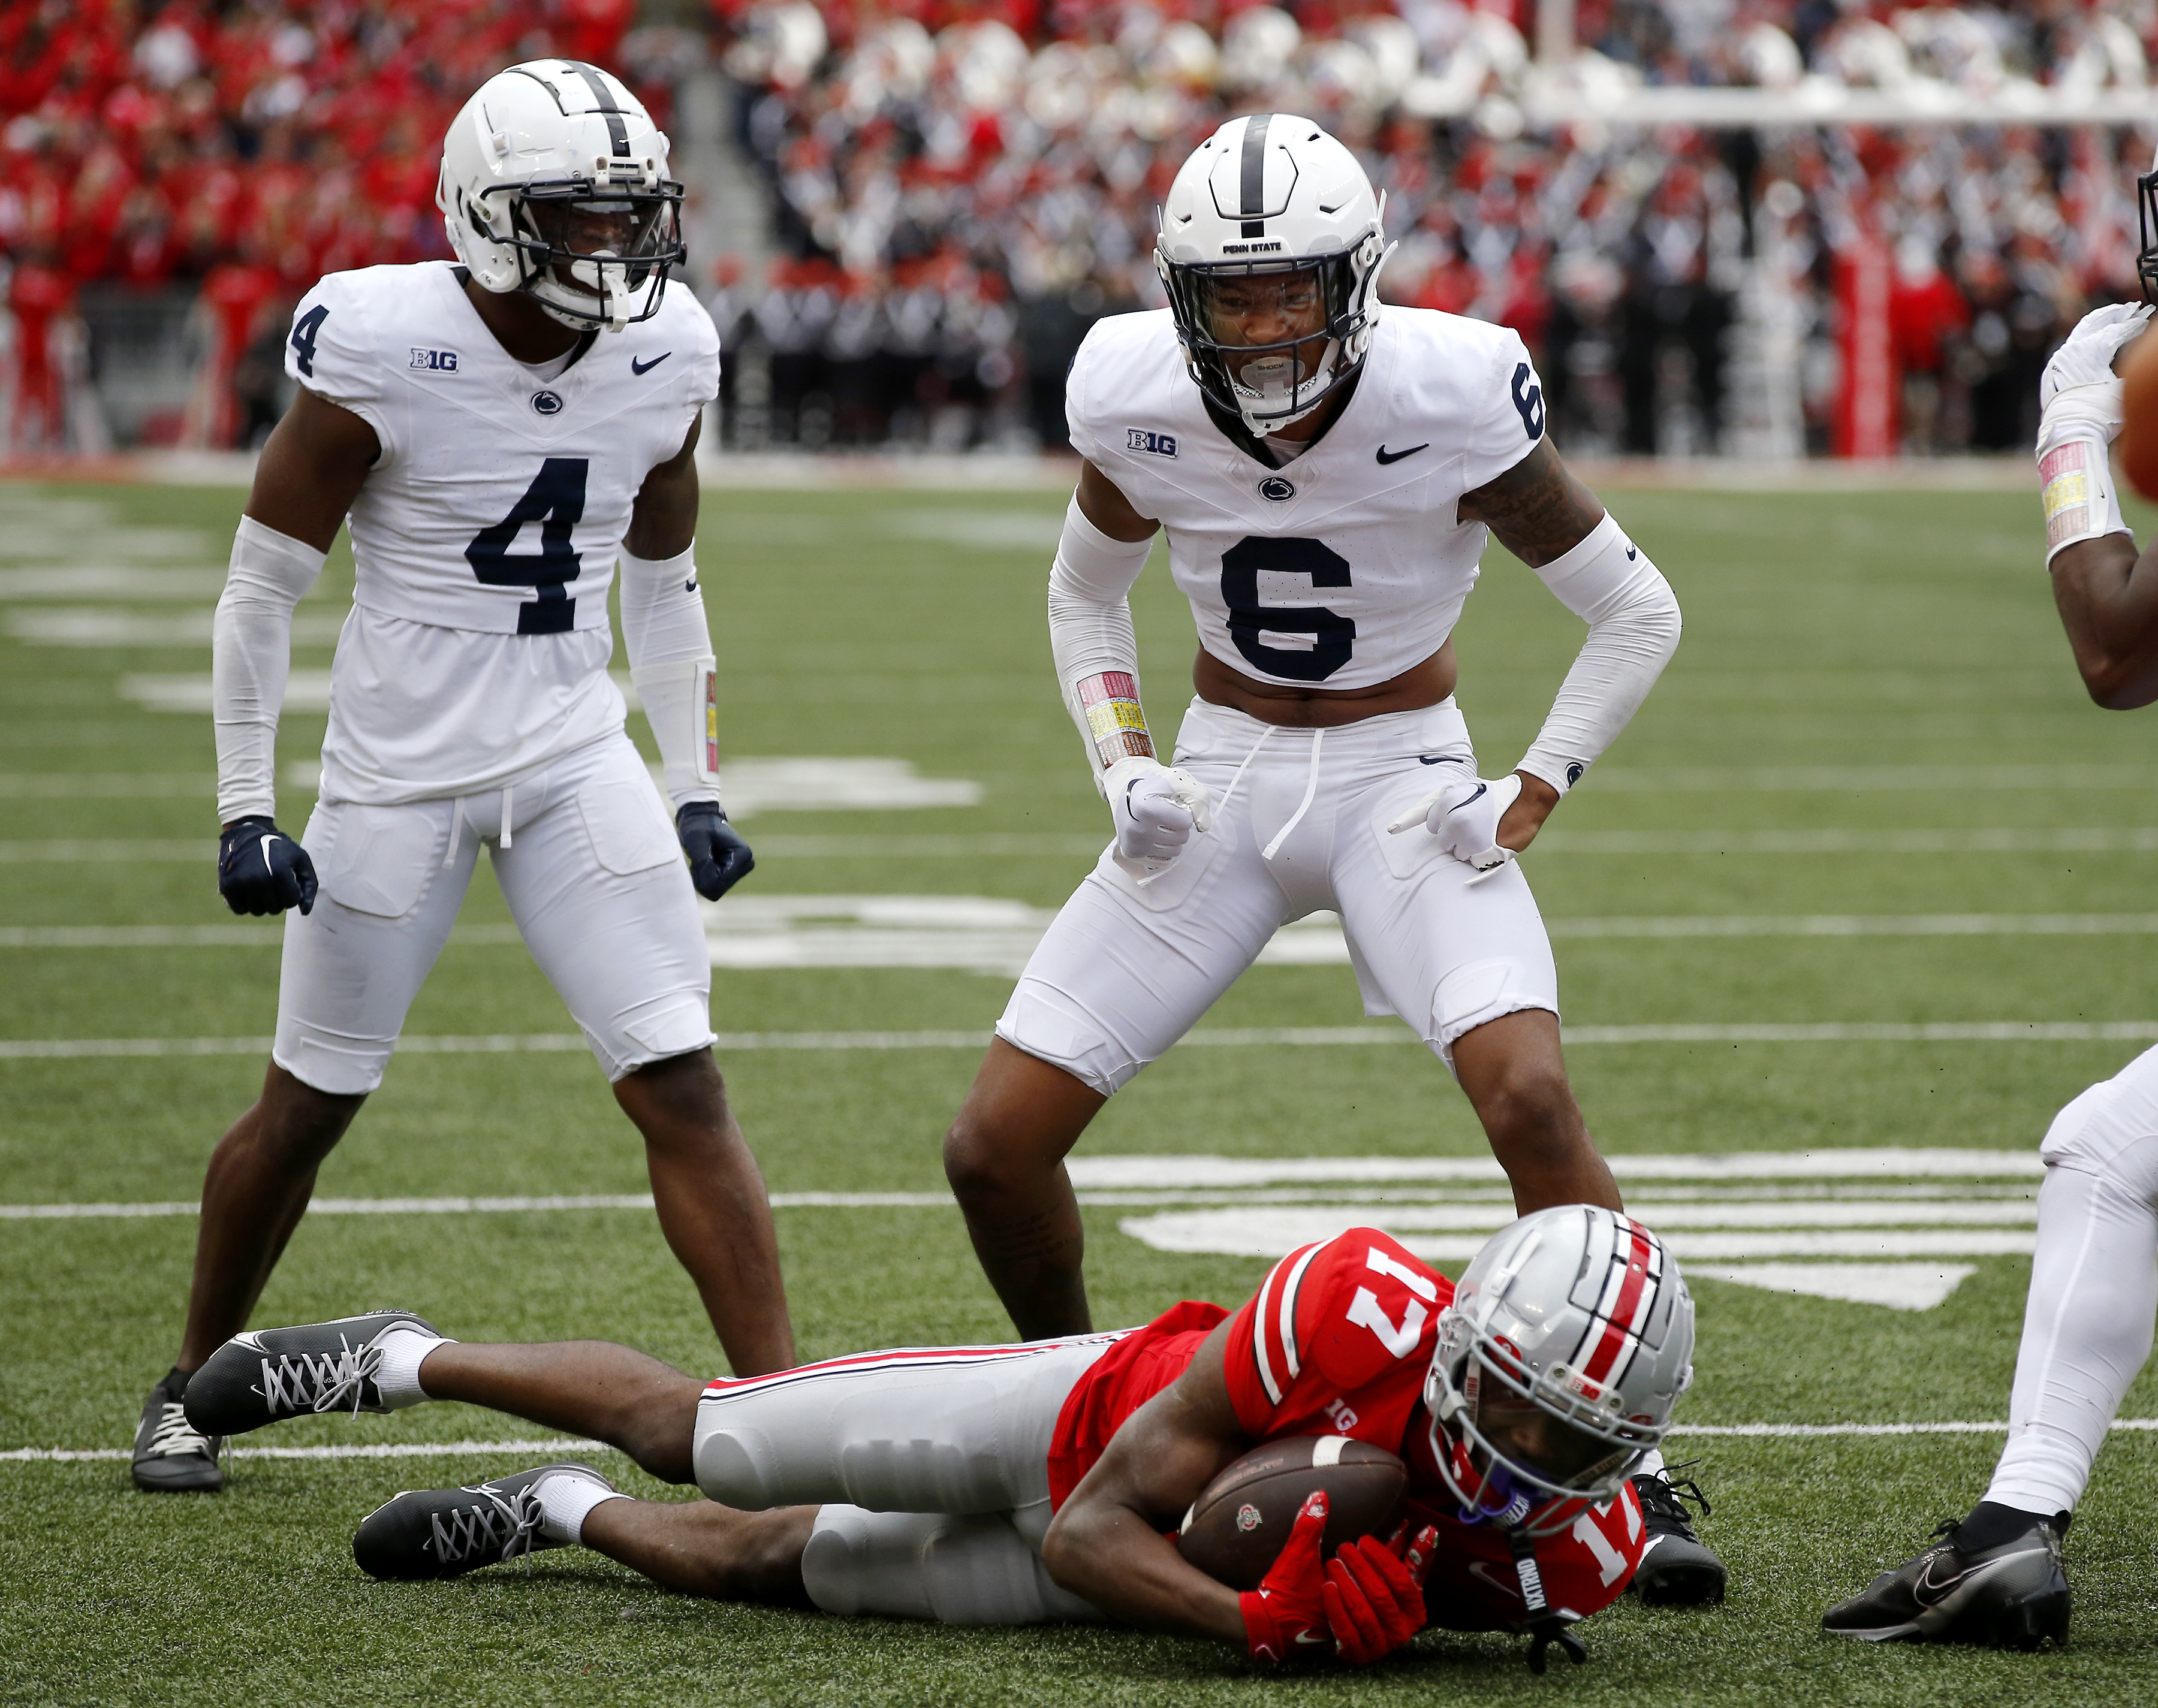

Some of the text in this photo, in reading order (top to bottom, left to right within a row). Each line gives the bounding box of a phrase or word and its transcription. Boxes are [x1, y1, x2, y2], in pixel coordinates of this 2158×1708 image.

[1222, 242, 1282, 254] PENN STATE
[291, 304, 330, 378] 4
[1512, 363, 1544, 440] 6
[464, 458, 589, 635] 4
[1221, 536, 1357, 681] 6
[1346, 1246, 1437, 1359] 17
[1572, 1486, 1642, 1588] 17
[1515, 1558, 1547, 1612] NXTRND
